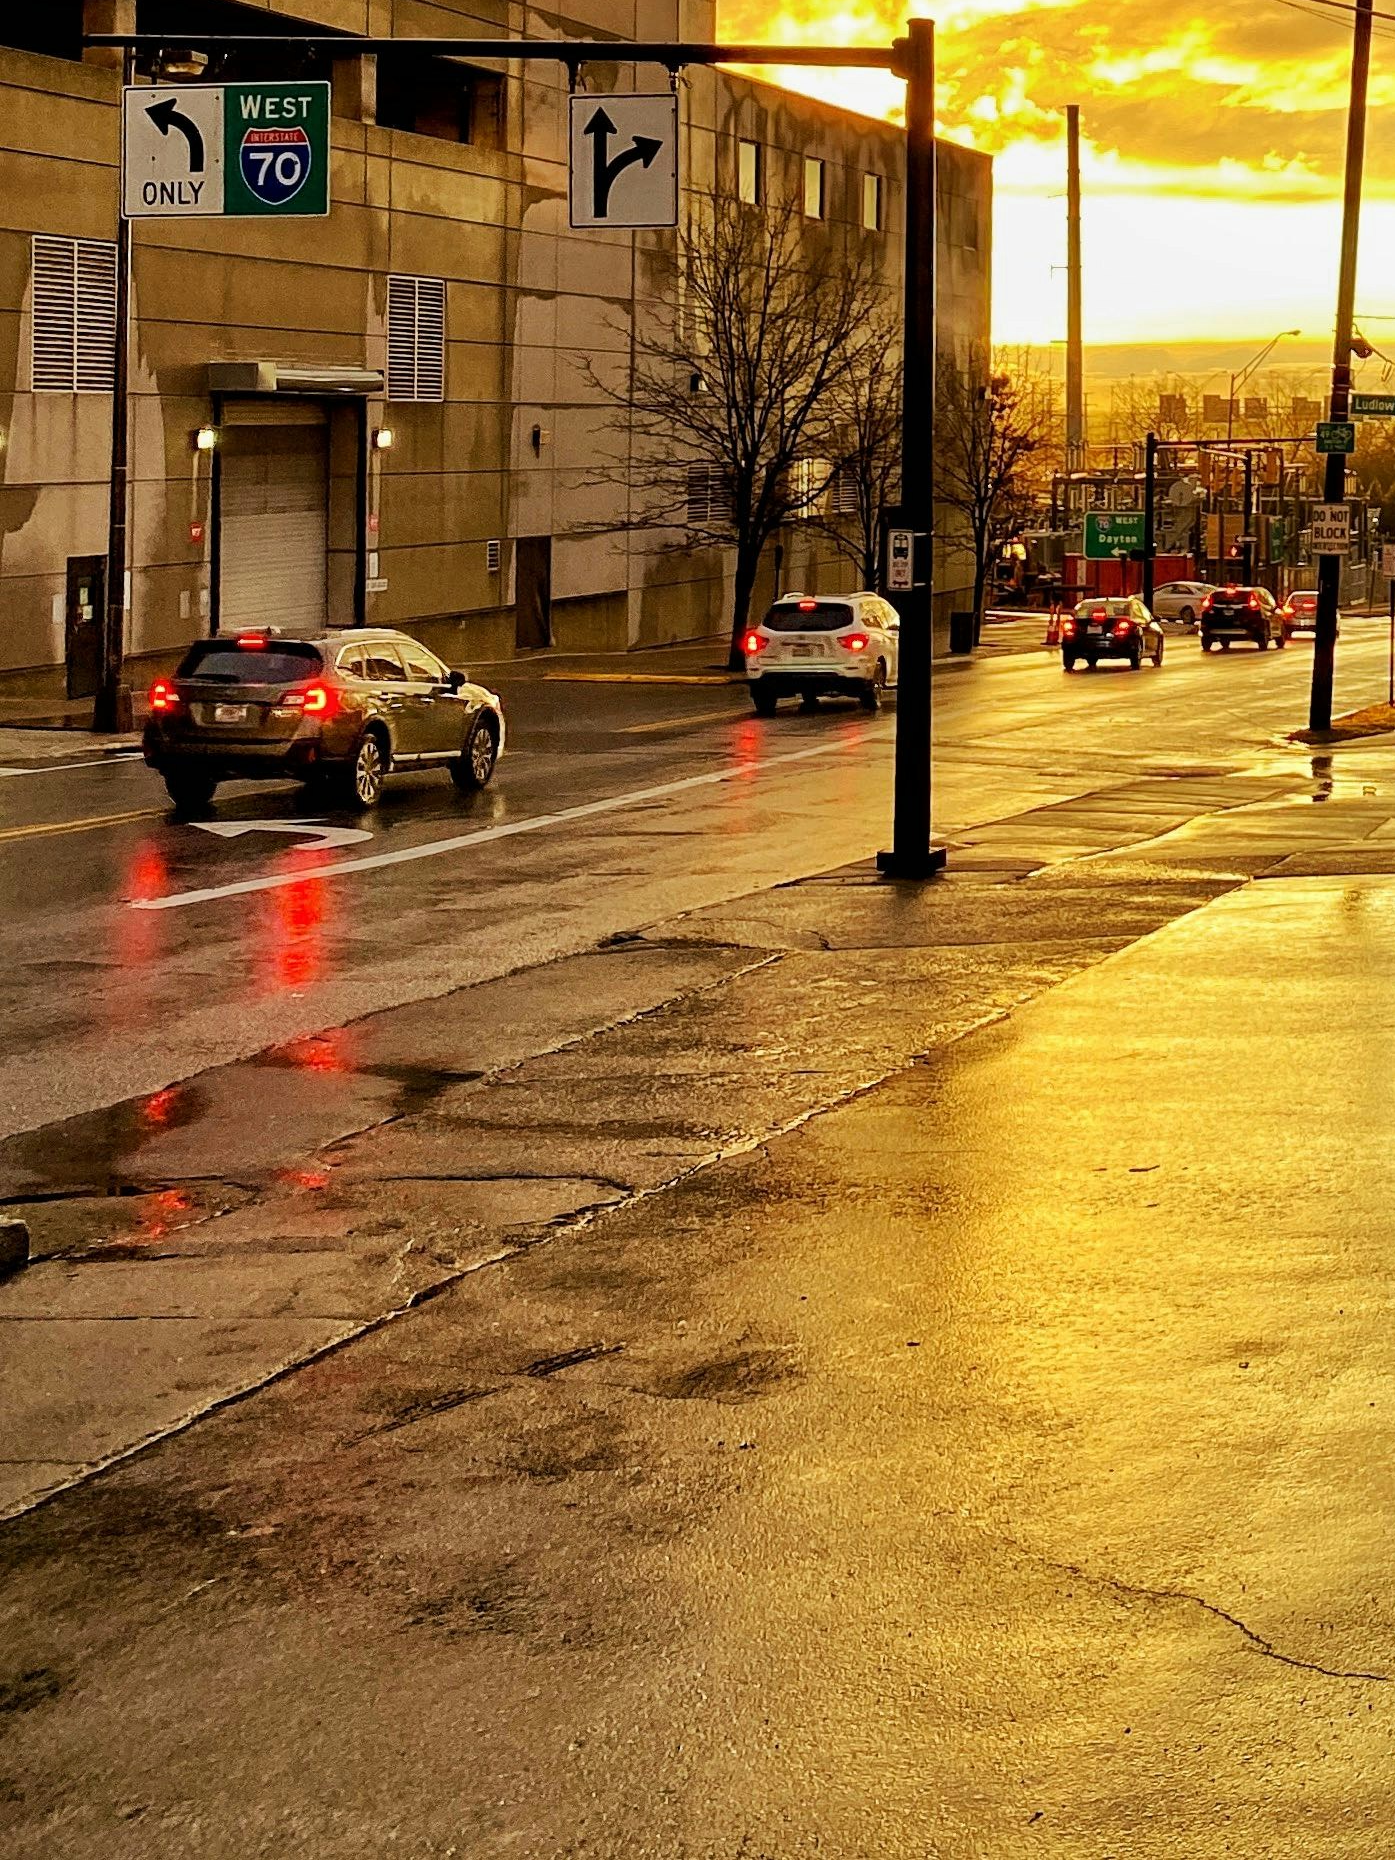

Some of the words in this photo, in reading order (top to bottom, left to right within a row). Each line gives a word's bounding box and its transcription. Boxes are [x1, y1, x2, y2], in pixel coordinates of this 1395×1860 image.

[240, 95, 312, 119] WEST
[250, 131, 299, 143] INTERSTATE
[249, 151, 301, 186] 70
[143, 180, 205, 206] ONLY
[1354, 397, 1395, 411] Ludlow
[1115, 516, 1138, 525] WEST
[1313, 510, 1326, 523] DO
[1330, 510, 1349, 524] NOT
[1098, 533, 1138, 545] Dayton
[1314, 526, 1347, 540] BLOCK
